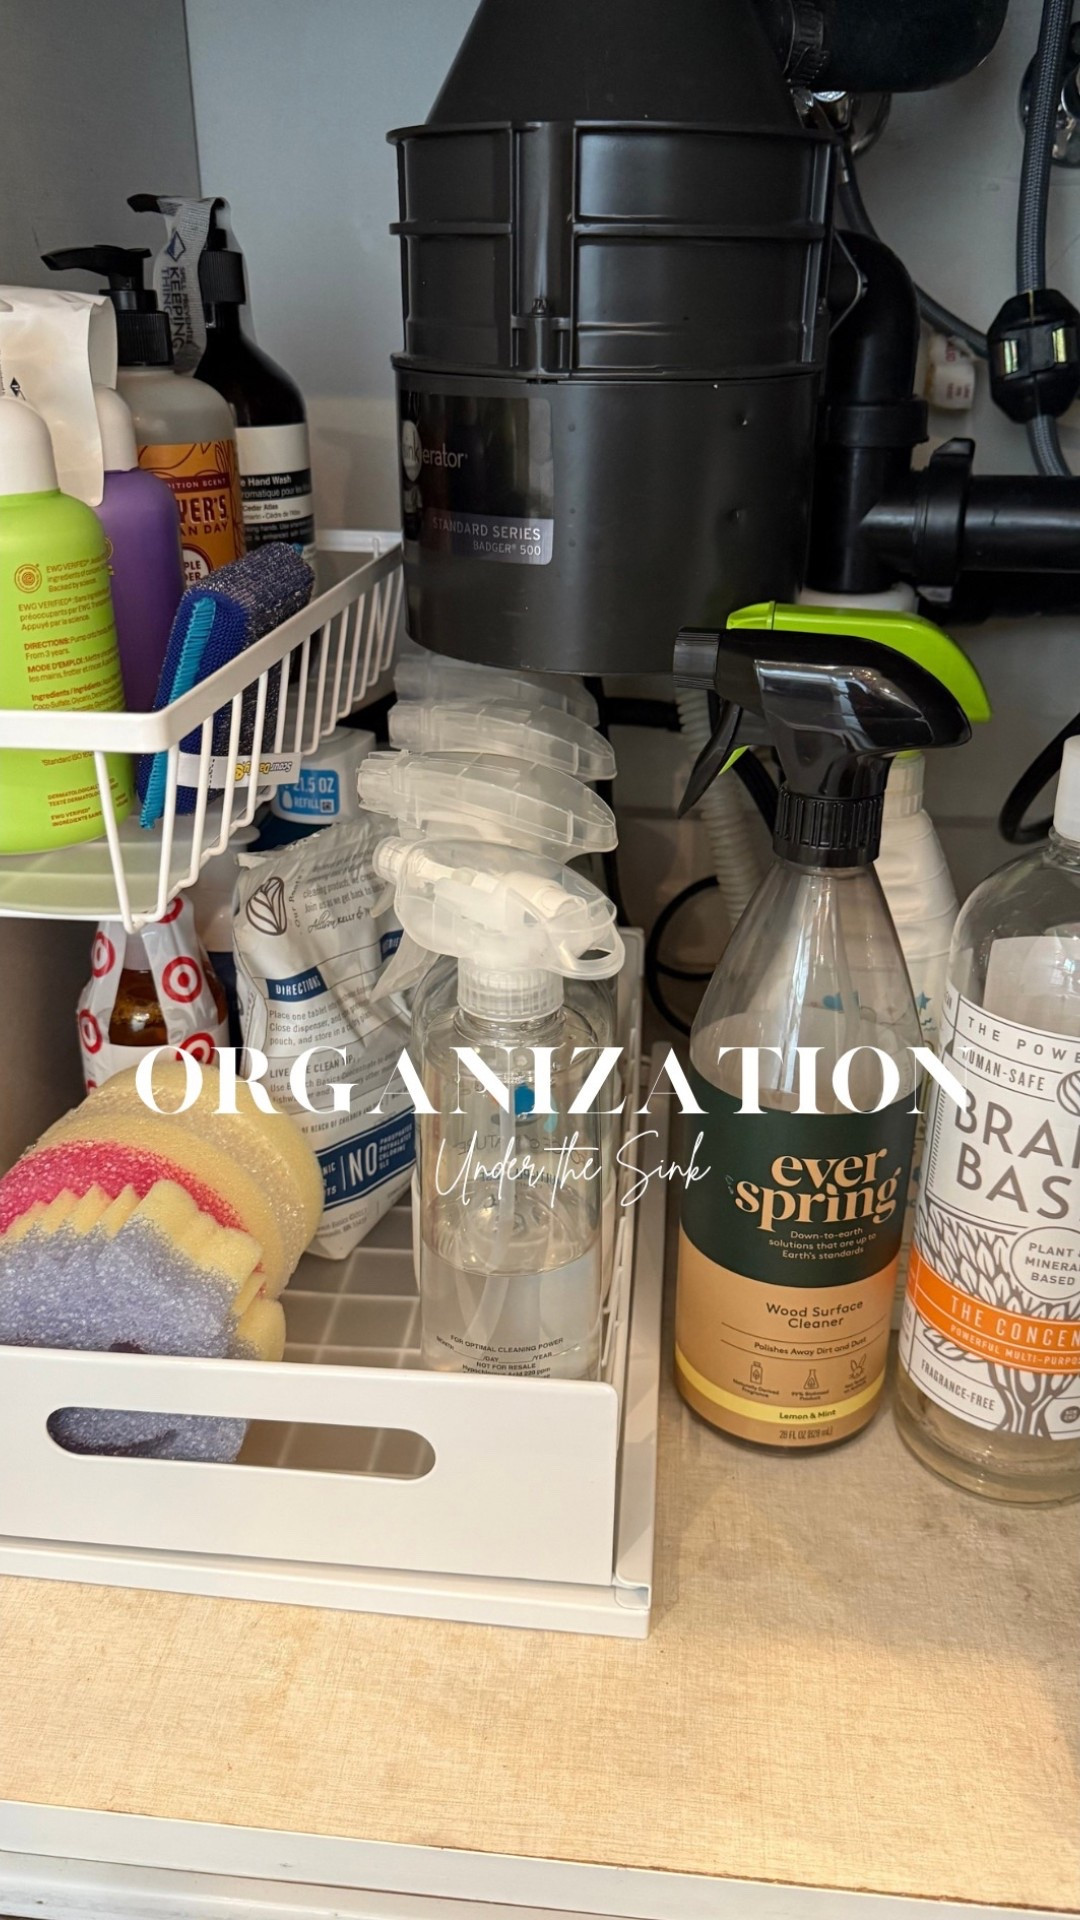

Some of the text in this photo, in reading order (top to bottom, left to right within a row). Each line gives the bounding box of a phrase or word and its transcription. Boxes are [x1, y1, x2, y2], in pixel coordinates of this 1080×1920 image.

[169, 266, 186, 351] KEEPING
[203, 478, 226, 487] SCENT
[247, 476, 271, 488] Hand
[272, 474, 292, 486] Wash
[241, 488, 280, 500] romatique
[281, 487, 295, 498] pour
[177, 494, 229, 525] YER'S
[204, 521, 228, 535] DAY
[432, 516, 541, 541] STANDARD SERIES
[520, 545, 541, 556] 500
[184, 560, 201, 570] PLE
[18, 602, 37, 611] EWG
[20, 608, 67, 622] préoccupants
[21, 621, 50, 632] Appuyé
[25, 651, 45, 660] From
[27, 663, 51, 673] MODE
[28, 674, 40, 683] les
[31, 689, 70, 702] Ingredients
[319, 777, 335, 794] OZ
[294, 798, 319, 810] REFILL
[275, 975, 322, 996] DIRECTIONS
[269, 1009, 290, 1020] Place
[292, 1012, 306, 1021] one
[307, 1005, 327, 1018] tablet
[269, 1021, 291, 1032] Close
[293, 1018, 330, 1033] dispenser,
[968, 1016, 1001, 1042] THE
[270, 1037, 296, 1047] pouch,
[298, 1034, 313, 1044] and
[315, 1029, 332, 1041] store
[333, 1028, 340, 1037] in
[270, 1067, 289, 1079] LIVE
[314, 1059, 340, 1073] CLEAN
[270, 1083, 285, 1093] Use
[316, 1075, 340, 1087] Basics
[315, 1087, 331, 1098] and
[311, 1122, 329, 1134] REACH
[331, 1118, 338, 1128] OF
[379, 1144, 406, 1160] CHLORINE
[348, 1142, 378, 1187] NO
[771, 1148, 888, 1189] ever
[735, 1167, 902, 1233] spring
[768, 1232, 877, 1250] solutions that are up to
[790, 1227, 863, 1240] Down-to-earth
[782, 1246, 864, 1260] Earth's standards
[1028, 1241, 1073, 1259] PLANT
[1030, 1272, 1075, 1287] BASED
[766, 1300, 863, 1318] Wood Surface
[951, 1295, 986, 1328] THE
[788, 1316, 844, 1329] Cleaner
[451, 1335, 564, 1353] FOR OPTIMAL CLEANING POWER
[754, 1336, 867, 1357] Polishes Away Dirt and Dust
[951, 1323, 1000, 1355] POWERFUL
[476, 1361, 536, 1371] NOT FOR RESALE
[921, 1358, 996, 1411] FRAGRANCE-FREE
[779, 1408, 836, 1420] Lemon & Mint
[779, 1429, 788, 1440] 28
[788, 1429, 796, 1440] FL
[797, 1429, 806, 1440] OZ
